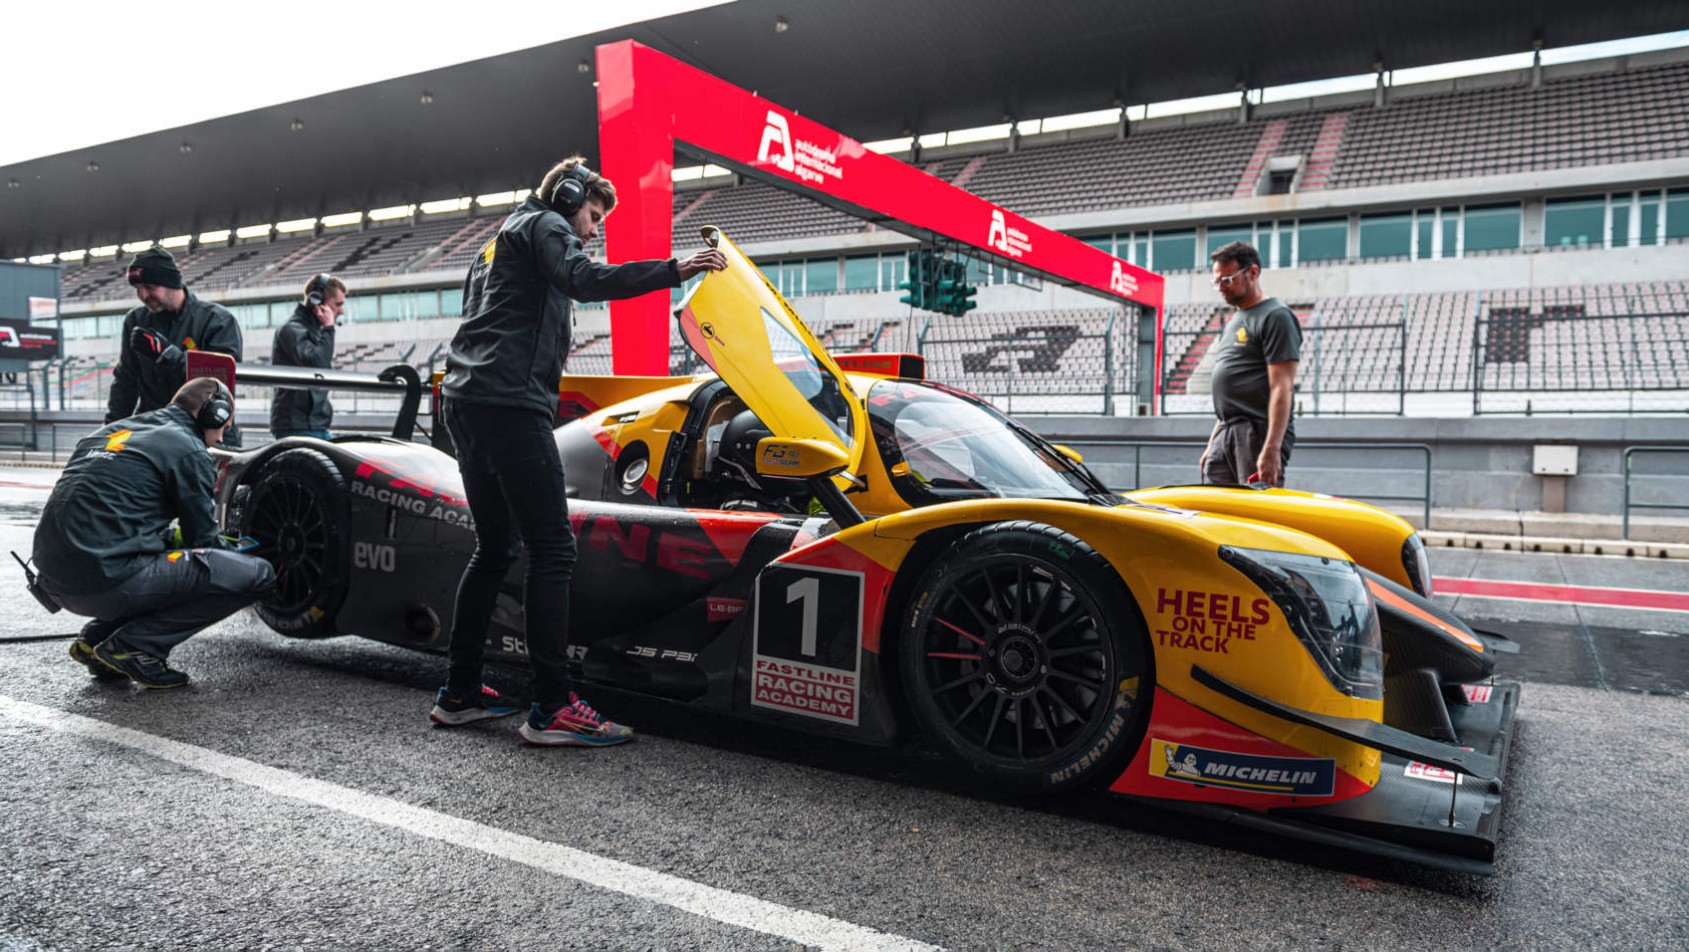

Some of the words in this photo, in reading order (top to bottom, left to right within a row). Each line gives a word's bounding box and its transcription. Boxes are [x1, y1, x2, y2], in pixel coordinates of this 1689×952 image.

[351, 480, 426, 515] RACING
[354, 541, 396, 573] evo
[786, 576, 820, 657] 1
[1156, 587, 1271, 626] HEELS
[1155, 629, 1229, 655] TRACK
[1171, 616, 1206, 635] ON
[1211, 620, 1257, 641] THE
[625, 645, 658, 658] JS
[756, 659, 857, 688] FASTLINE
[757, 673, 851, 704] RACING
[757, 689, 850, 717] ACADEMY
[1050, 713, 1125, 784] MICHELIN
[1204, 761, 1317, 785] MICHELIN
